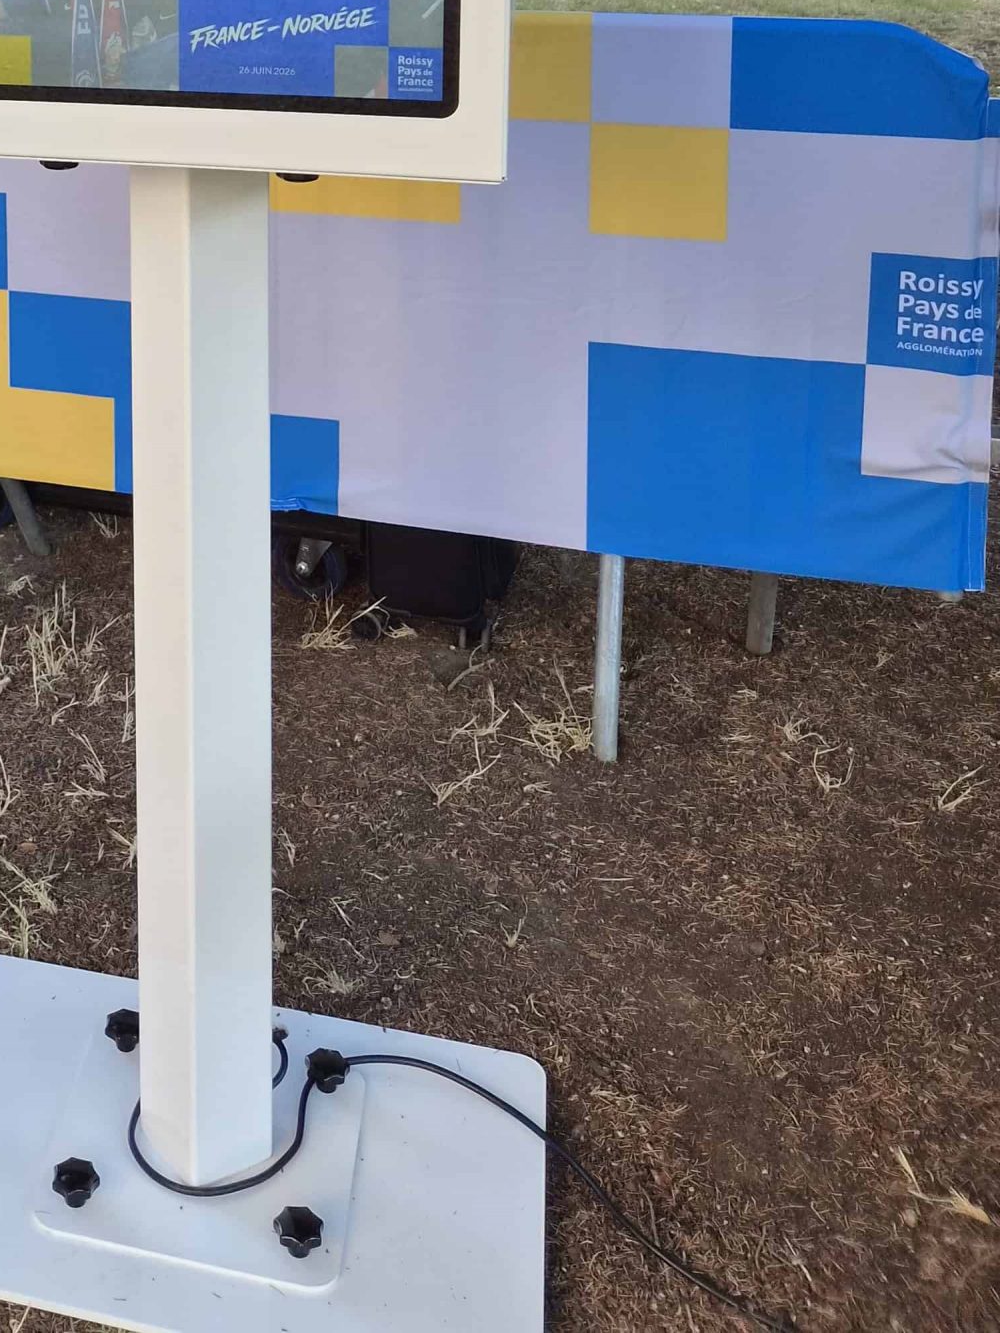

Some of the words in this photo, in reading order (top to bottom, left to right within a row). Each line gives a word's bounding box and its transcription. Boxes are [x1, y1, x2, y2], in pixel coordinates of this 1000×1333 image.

[397, 55, 434, 68] Roissy
[239, 65, 250, 75] 26
[251, 65, 272, 75] JUIN
[273, 67, 296, 76] 2026
[397, 66, 422, 77] Pays
[423, 68, 433, 76] de
[397, 76, 434, 87] France
[899, 270, 984, 300] Roissy
[898, 294, 959, 321] Pays
[964, 305, 982, 320] de
[897, 317, 985, 343] France
[896, 341, 983, 357] AGGLOMÉRATION
